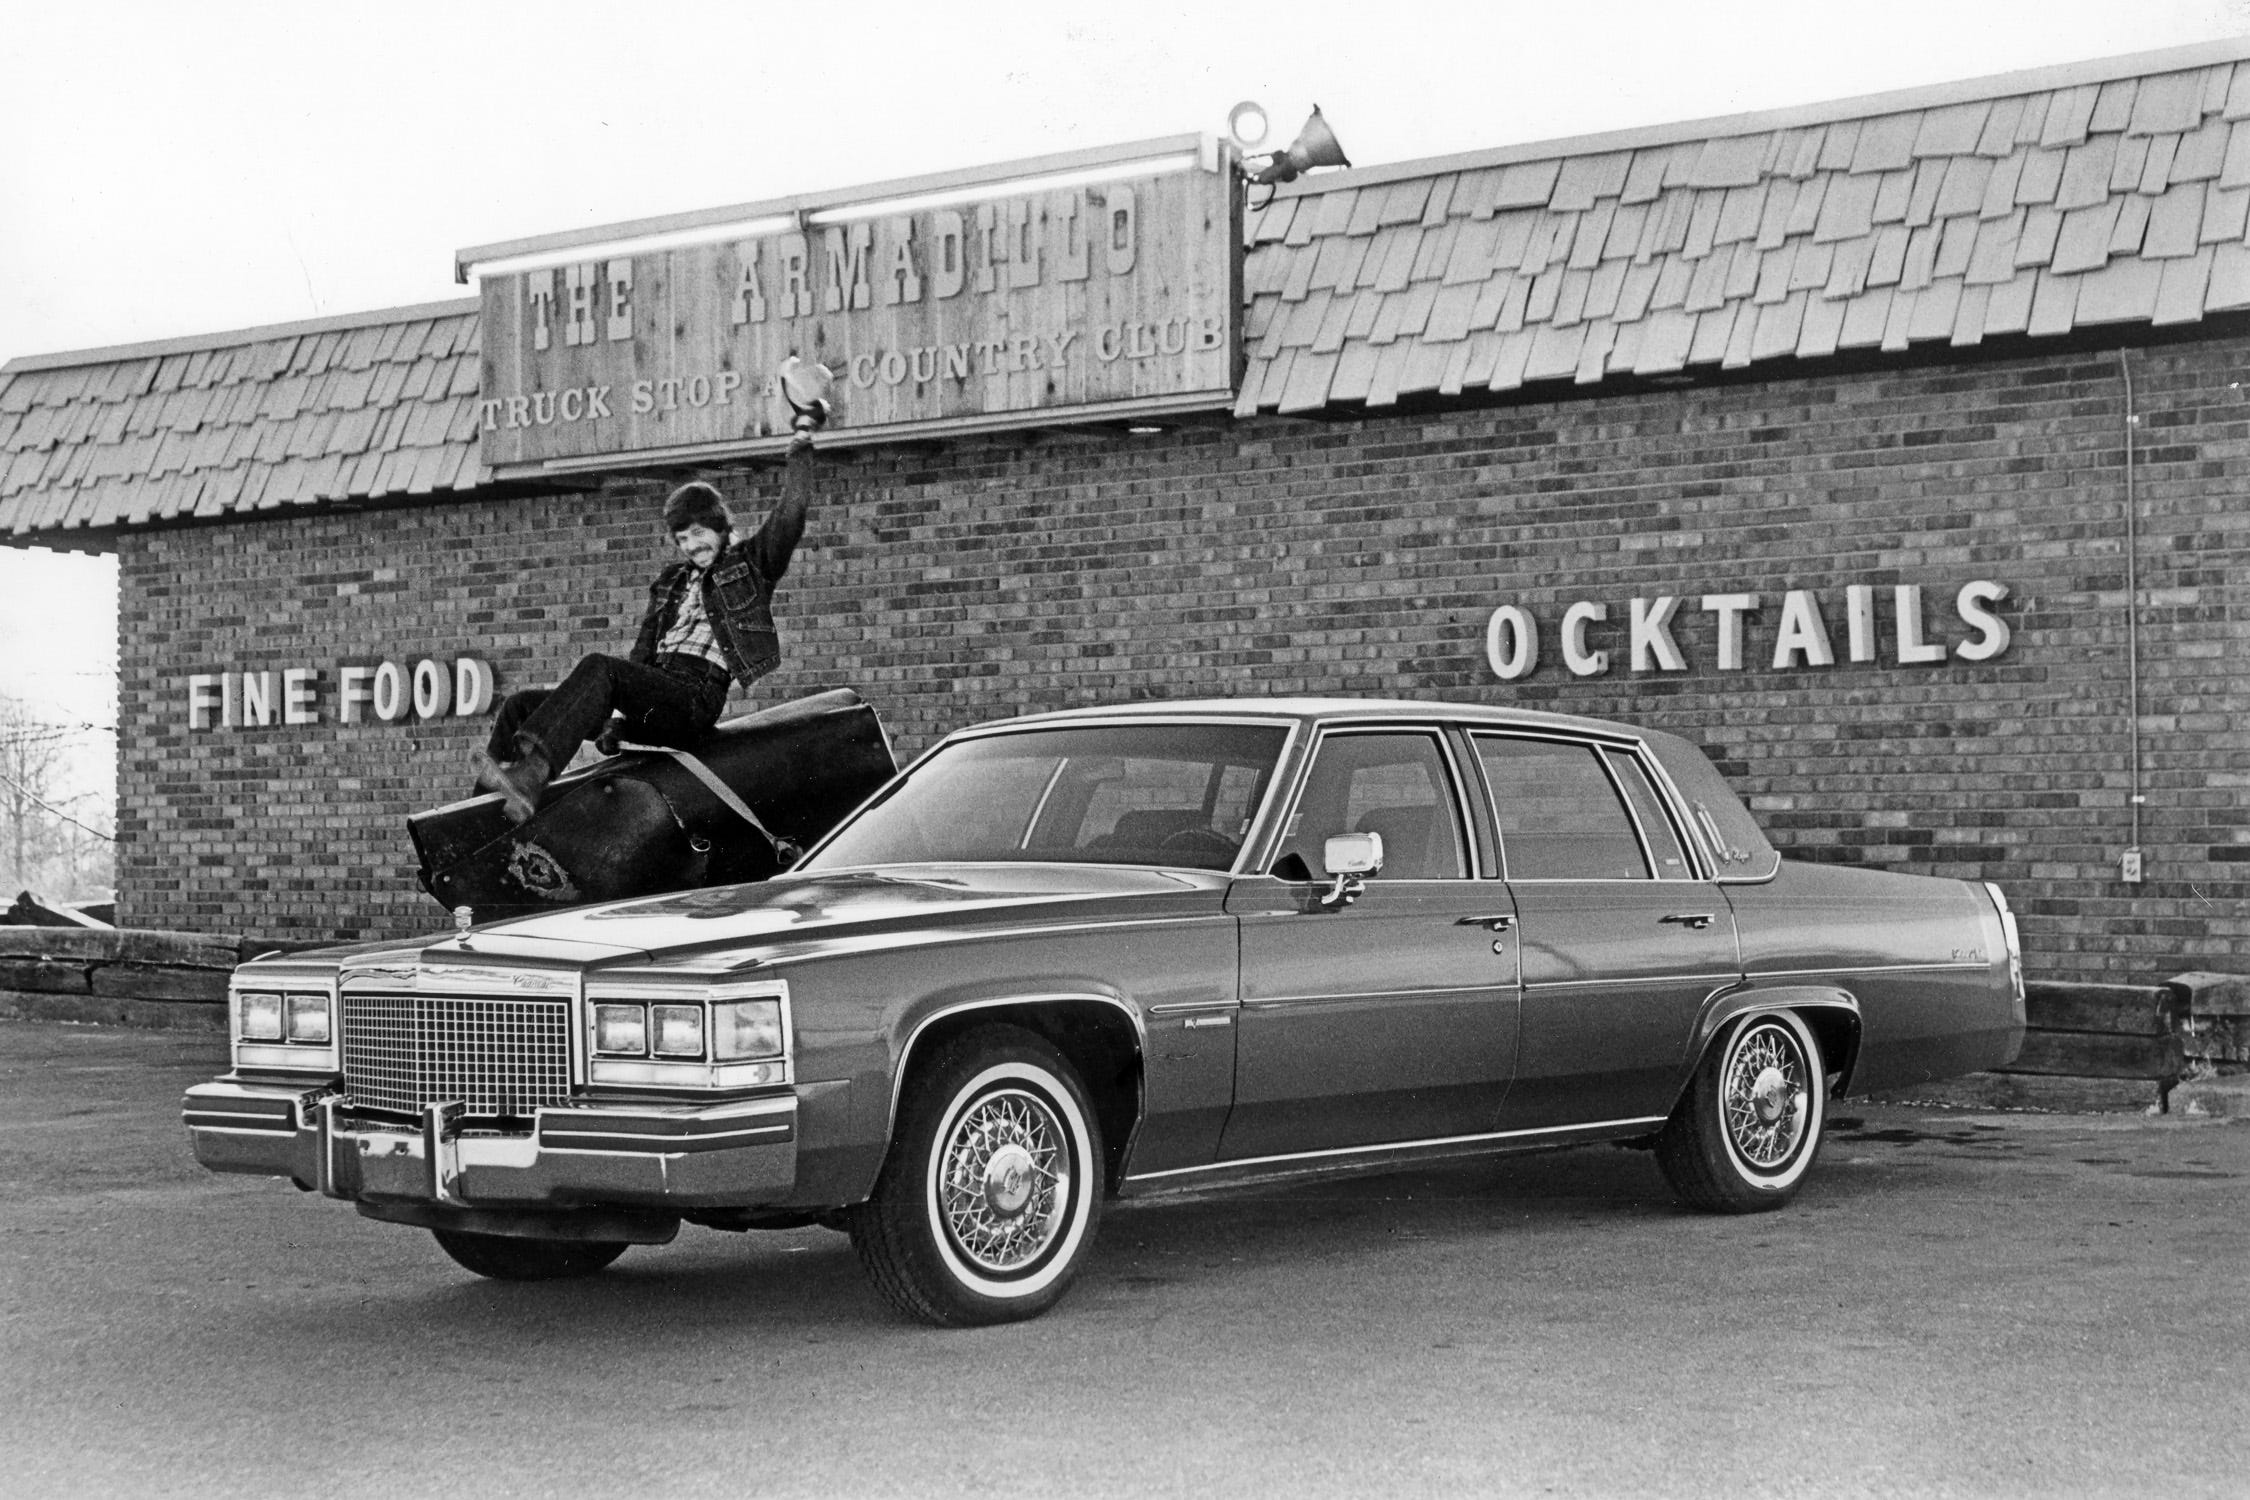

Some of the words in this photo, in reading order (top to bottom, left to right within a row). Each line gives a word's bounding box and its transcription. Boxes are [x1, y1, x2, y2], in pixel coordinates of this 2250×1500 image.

[529, 257, 634, 350] THE
[731, 184, 1137, 325] ARMADILLO
[480, 384, 614, 431] TRUCK
[631, 370, 742, 414] STOP
[851, 330, 1079, 389] COUNTRY
[1095, 314, 1224, 362] CLUB
[1486, 579, 2011, 680] OCKTAILS
[189, 668, 319, 729] FINE
[340, 657, 495, 722] FOOD
